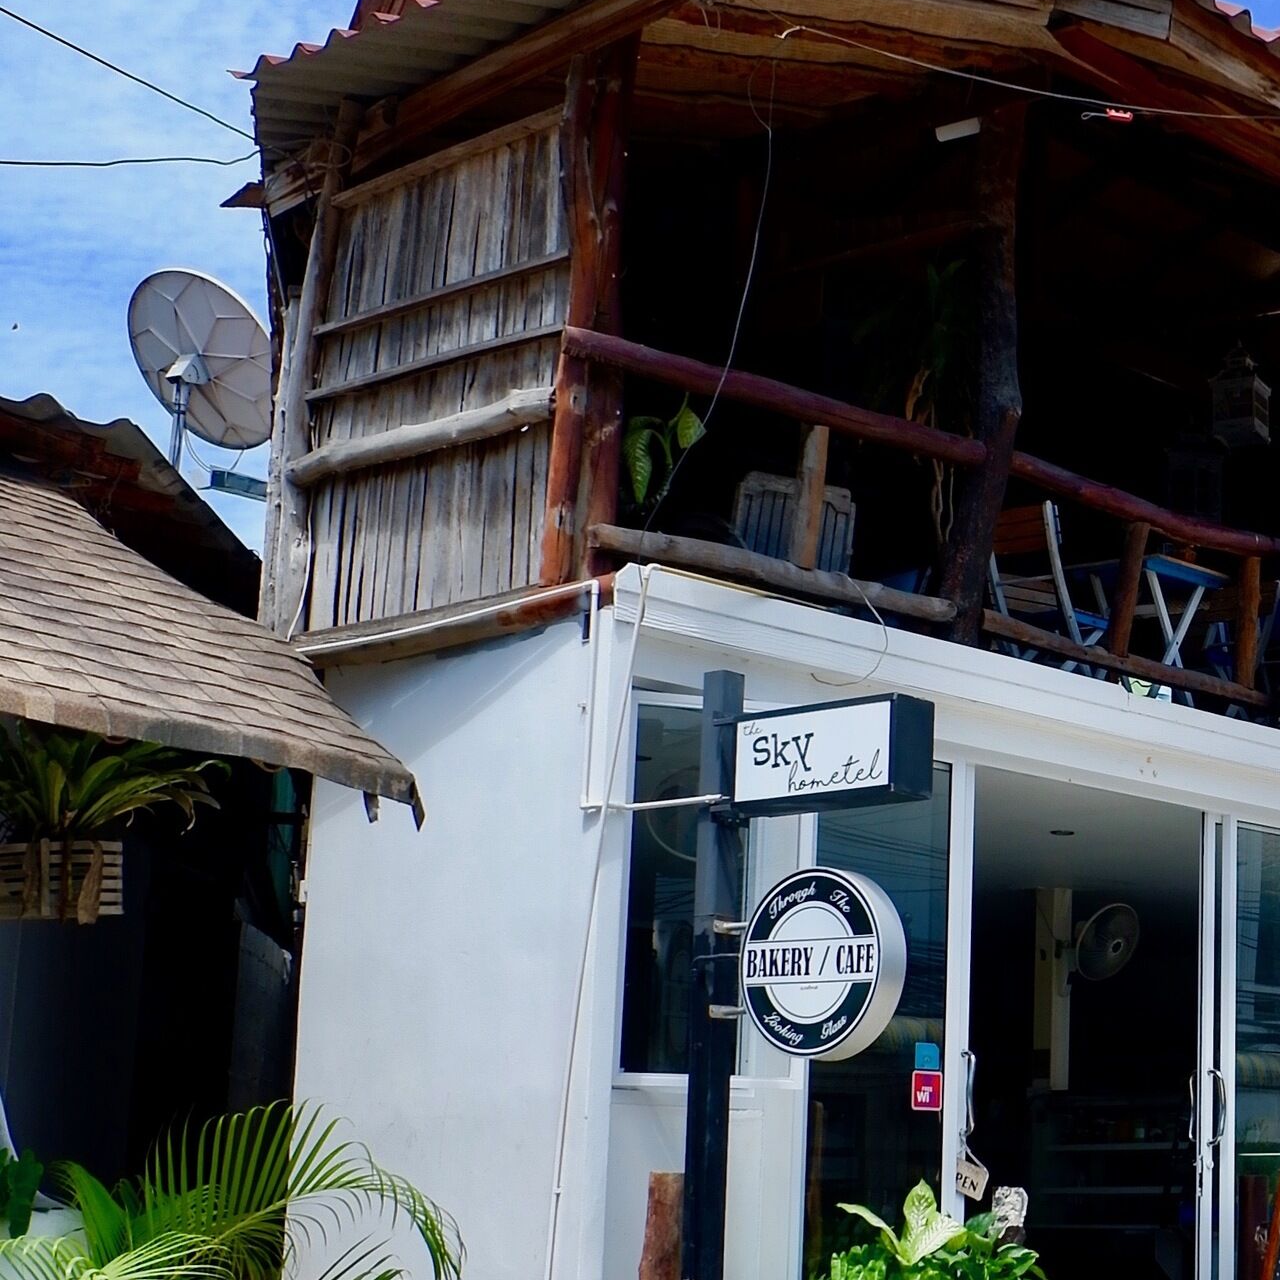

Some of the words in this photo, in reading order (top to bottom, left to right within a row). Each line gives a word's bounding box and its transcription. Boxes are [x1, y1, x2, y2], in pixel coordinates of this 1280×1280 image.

[743, 721, 763, 736] the
[788, 748, 883, 793] hometel
[768, 881, 816, 919] Through
[829, 889, 851, 913] The
[746, 946, 814, 979] BAKERY
[836, 943, 875, 975] CAFE
[763, 1011, 804, 1045] Looking
[820, 1015, 848, 1040] Glass
[956, 1172, 979, 1193] PEN
